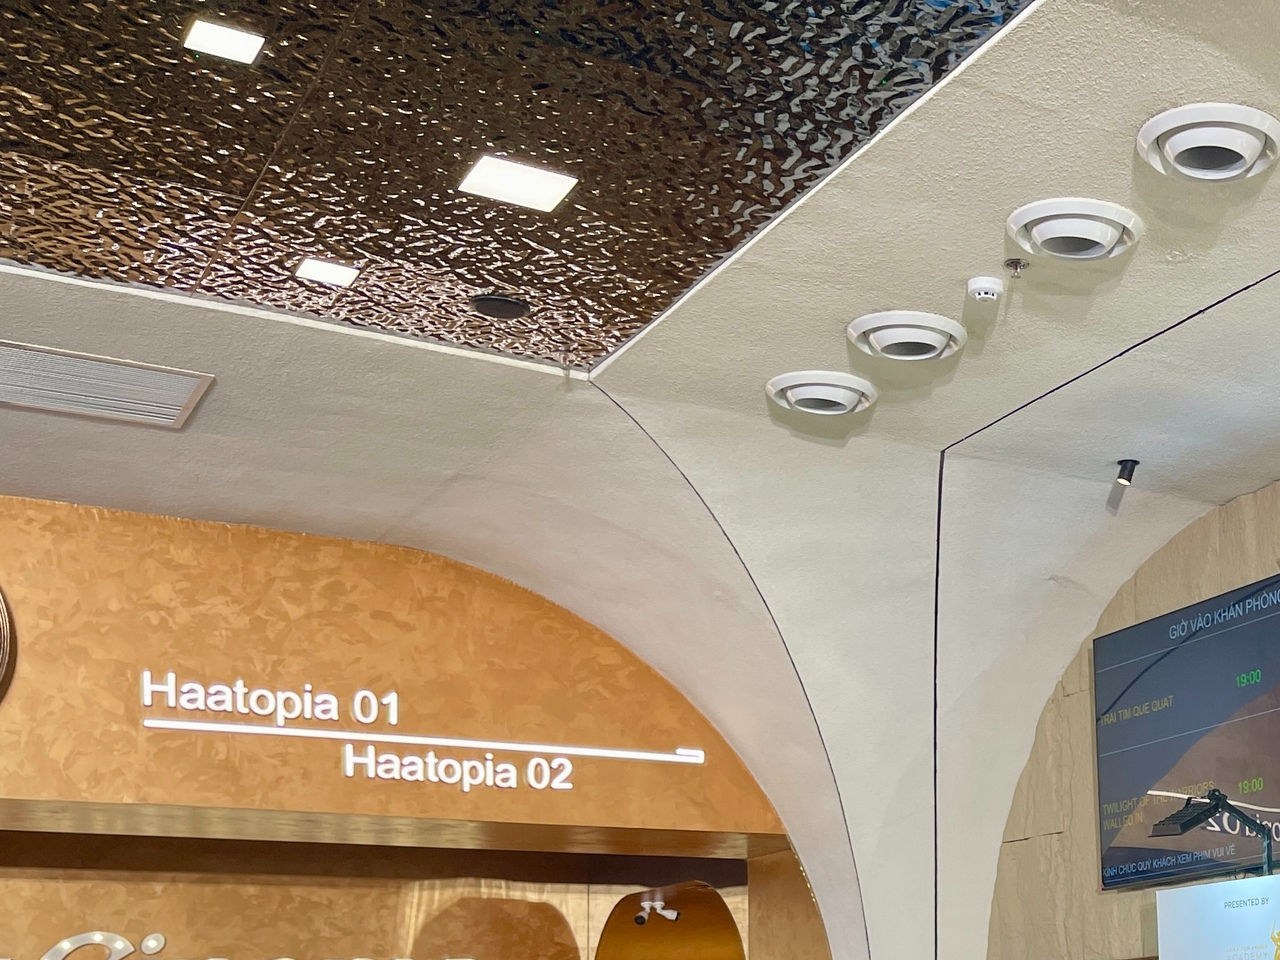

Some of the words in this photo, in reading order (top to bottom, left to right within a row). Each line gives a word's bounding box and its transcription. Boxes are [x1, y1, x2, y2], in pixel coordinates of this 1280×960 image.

[1169, 619, 1189, 639] GIỜ
[1190, 613, 1211, 632] VÀO
[1213, 602, 1243, 624] KHÁN
[1236, 669, 1261, 688] 19:00
[142, 670, 339, 727] Haatopia
[353, 689, 400, 725] 01
[343, 742, 518, 792] Haatopia
[526, 757, 573, 790] 02
[1238, 777, 1264, 795] 19:00
[1103, 798, 1138, 815] TWILIGHT
[1140, 796, 1150, 807] OF
[1103, 815, 1134, 830] WALLED
[1135, 812, 1143, 824] IN
[1177, 851, 1192, 865] XEM
[1193, 849, 1211, 862] PHIM
[1212, 846, 1225, 859] VUI
[1224, 897, 1260, 909] PRESENTED
[1261, 896, 1270, 905] BY
